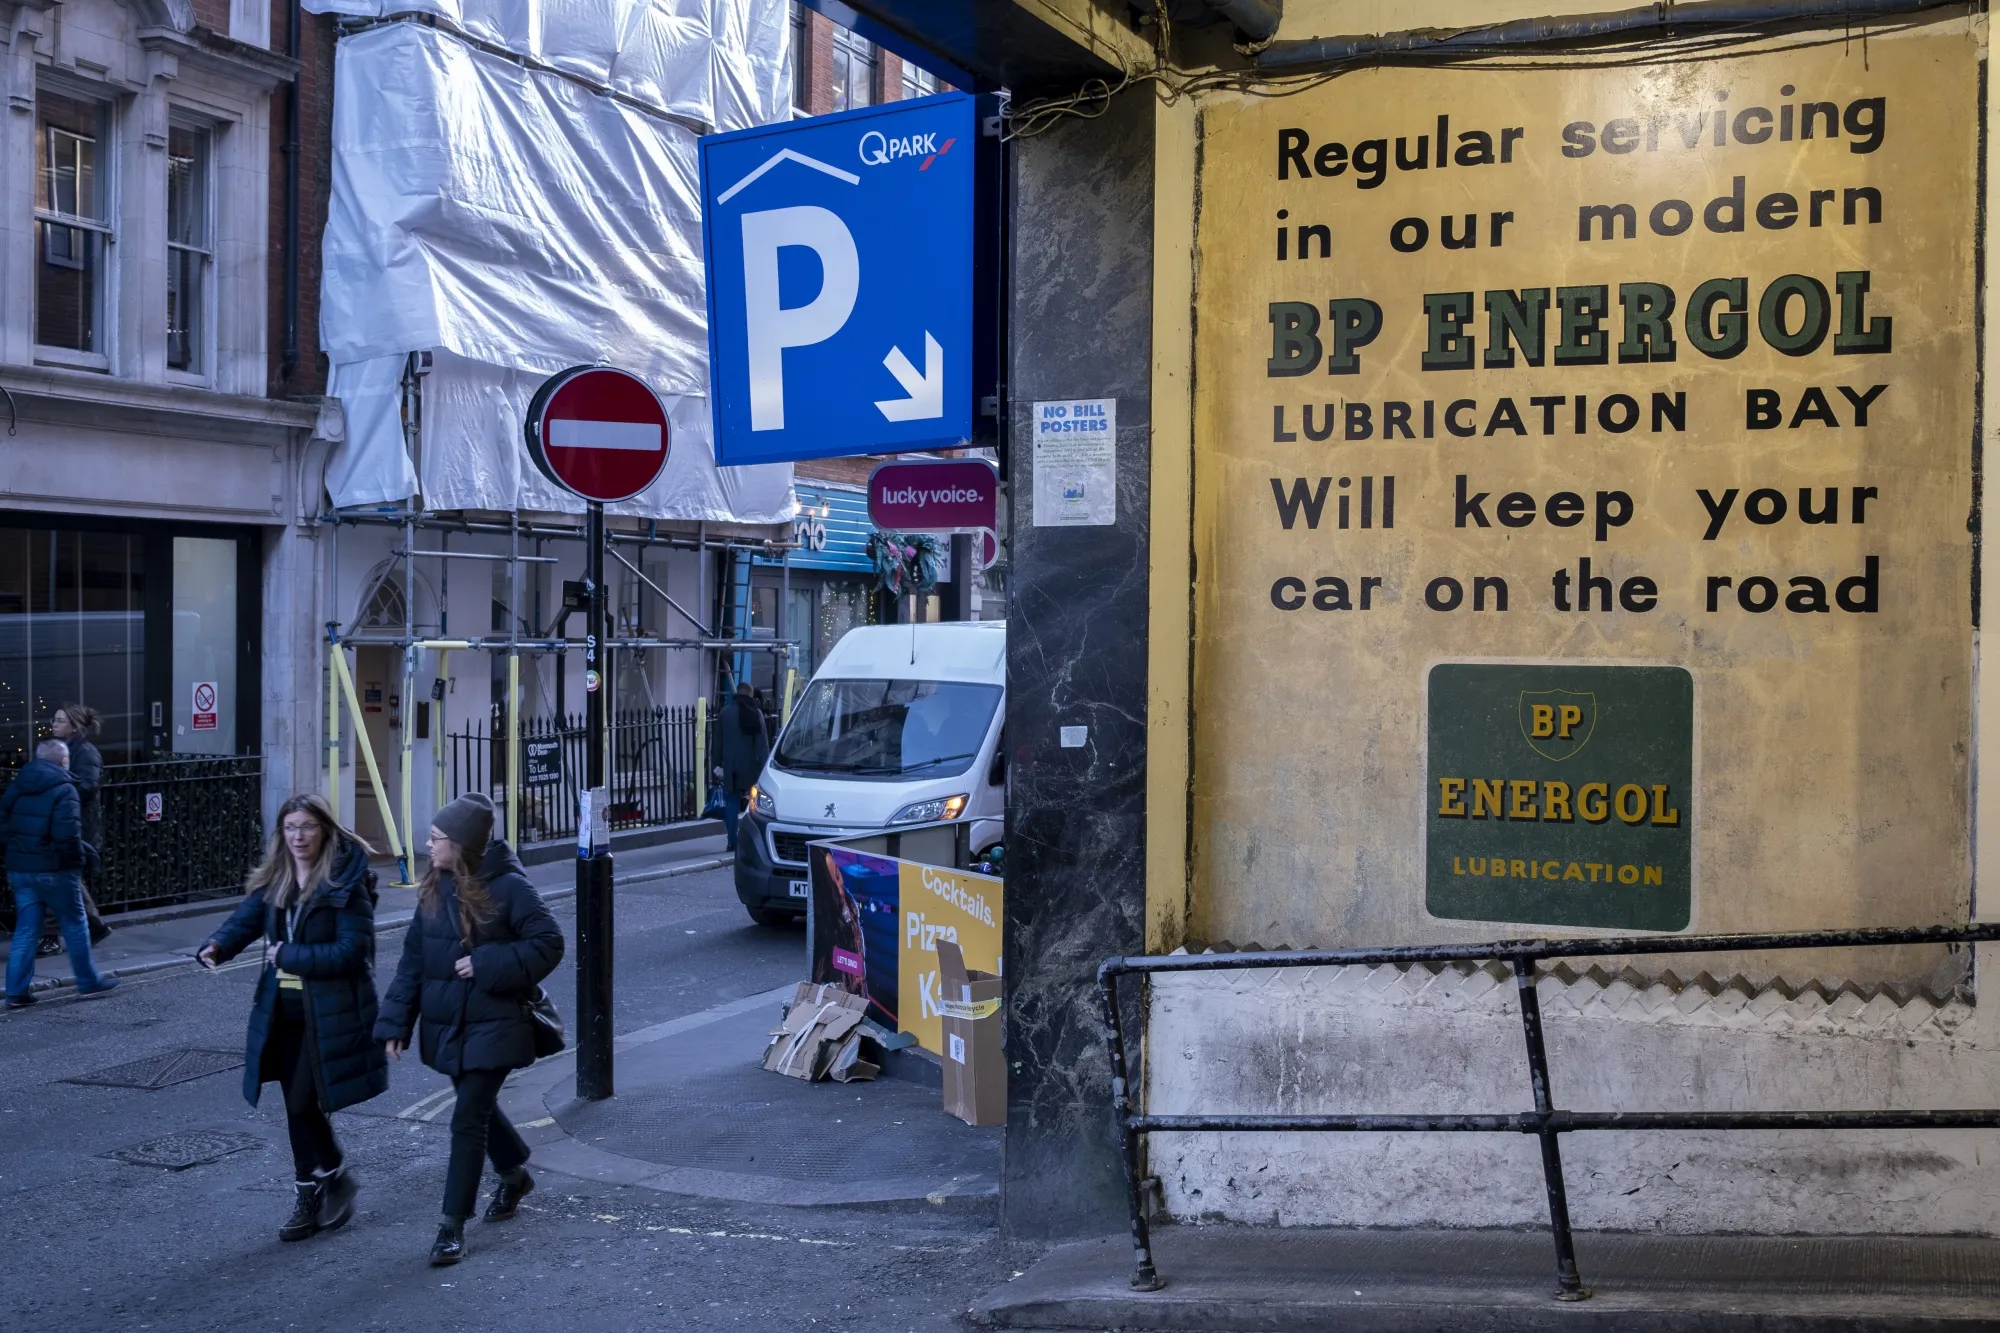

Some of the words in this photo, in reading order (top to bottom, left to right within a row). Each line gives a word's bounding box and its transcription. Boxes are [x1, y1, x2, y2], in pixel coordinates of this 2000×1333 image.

[1278, 114, 1524, 189] Regular
[1561, 84, 1886, 158] servicing
[1276, 209, 1331, 261] in
[1390, 211, 1514, 253] our
[1578, 175, 1882, 241] modern
[741, 205, 860, 431] P
[1267, 297, 1383, 377] BP
[1421, 270, 1892, 372] ENERGOL
[1040, 419, 1108, 433] POSTERS
[1043, 406, 1067, 418] NO
[1073, 405, 1105, 417] BILL
[1273, 391, 1686, 442] LUBRICATION
[1746, 384, 1889, 430] BAY
[882, 486, 928, 508] lucky
[1269, 476, 1395, 529] Will
[1454, 474, 1634, 541] keep
[1695, 486, 1878, 541] your
[1270, 576, 1382, 611] car
[1424, 576, 1508, 612] on
[1552, 557, 1658, 613] the
[1706, 555, 1879, 613] road
[1530, 704, 1584, 740] BP
[528, 764, 536, 773] To
[537, 763, 547, 773] Let
[1438, 777, 1681, 828] ENERGOL
[922, 866, 996, 929] Cocktails.
[1453, 856, 1663, 886] LUBRICATION
